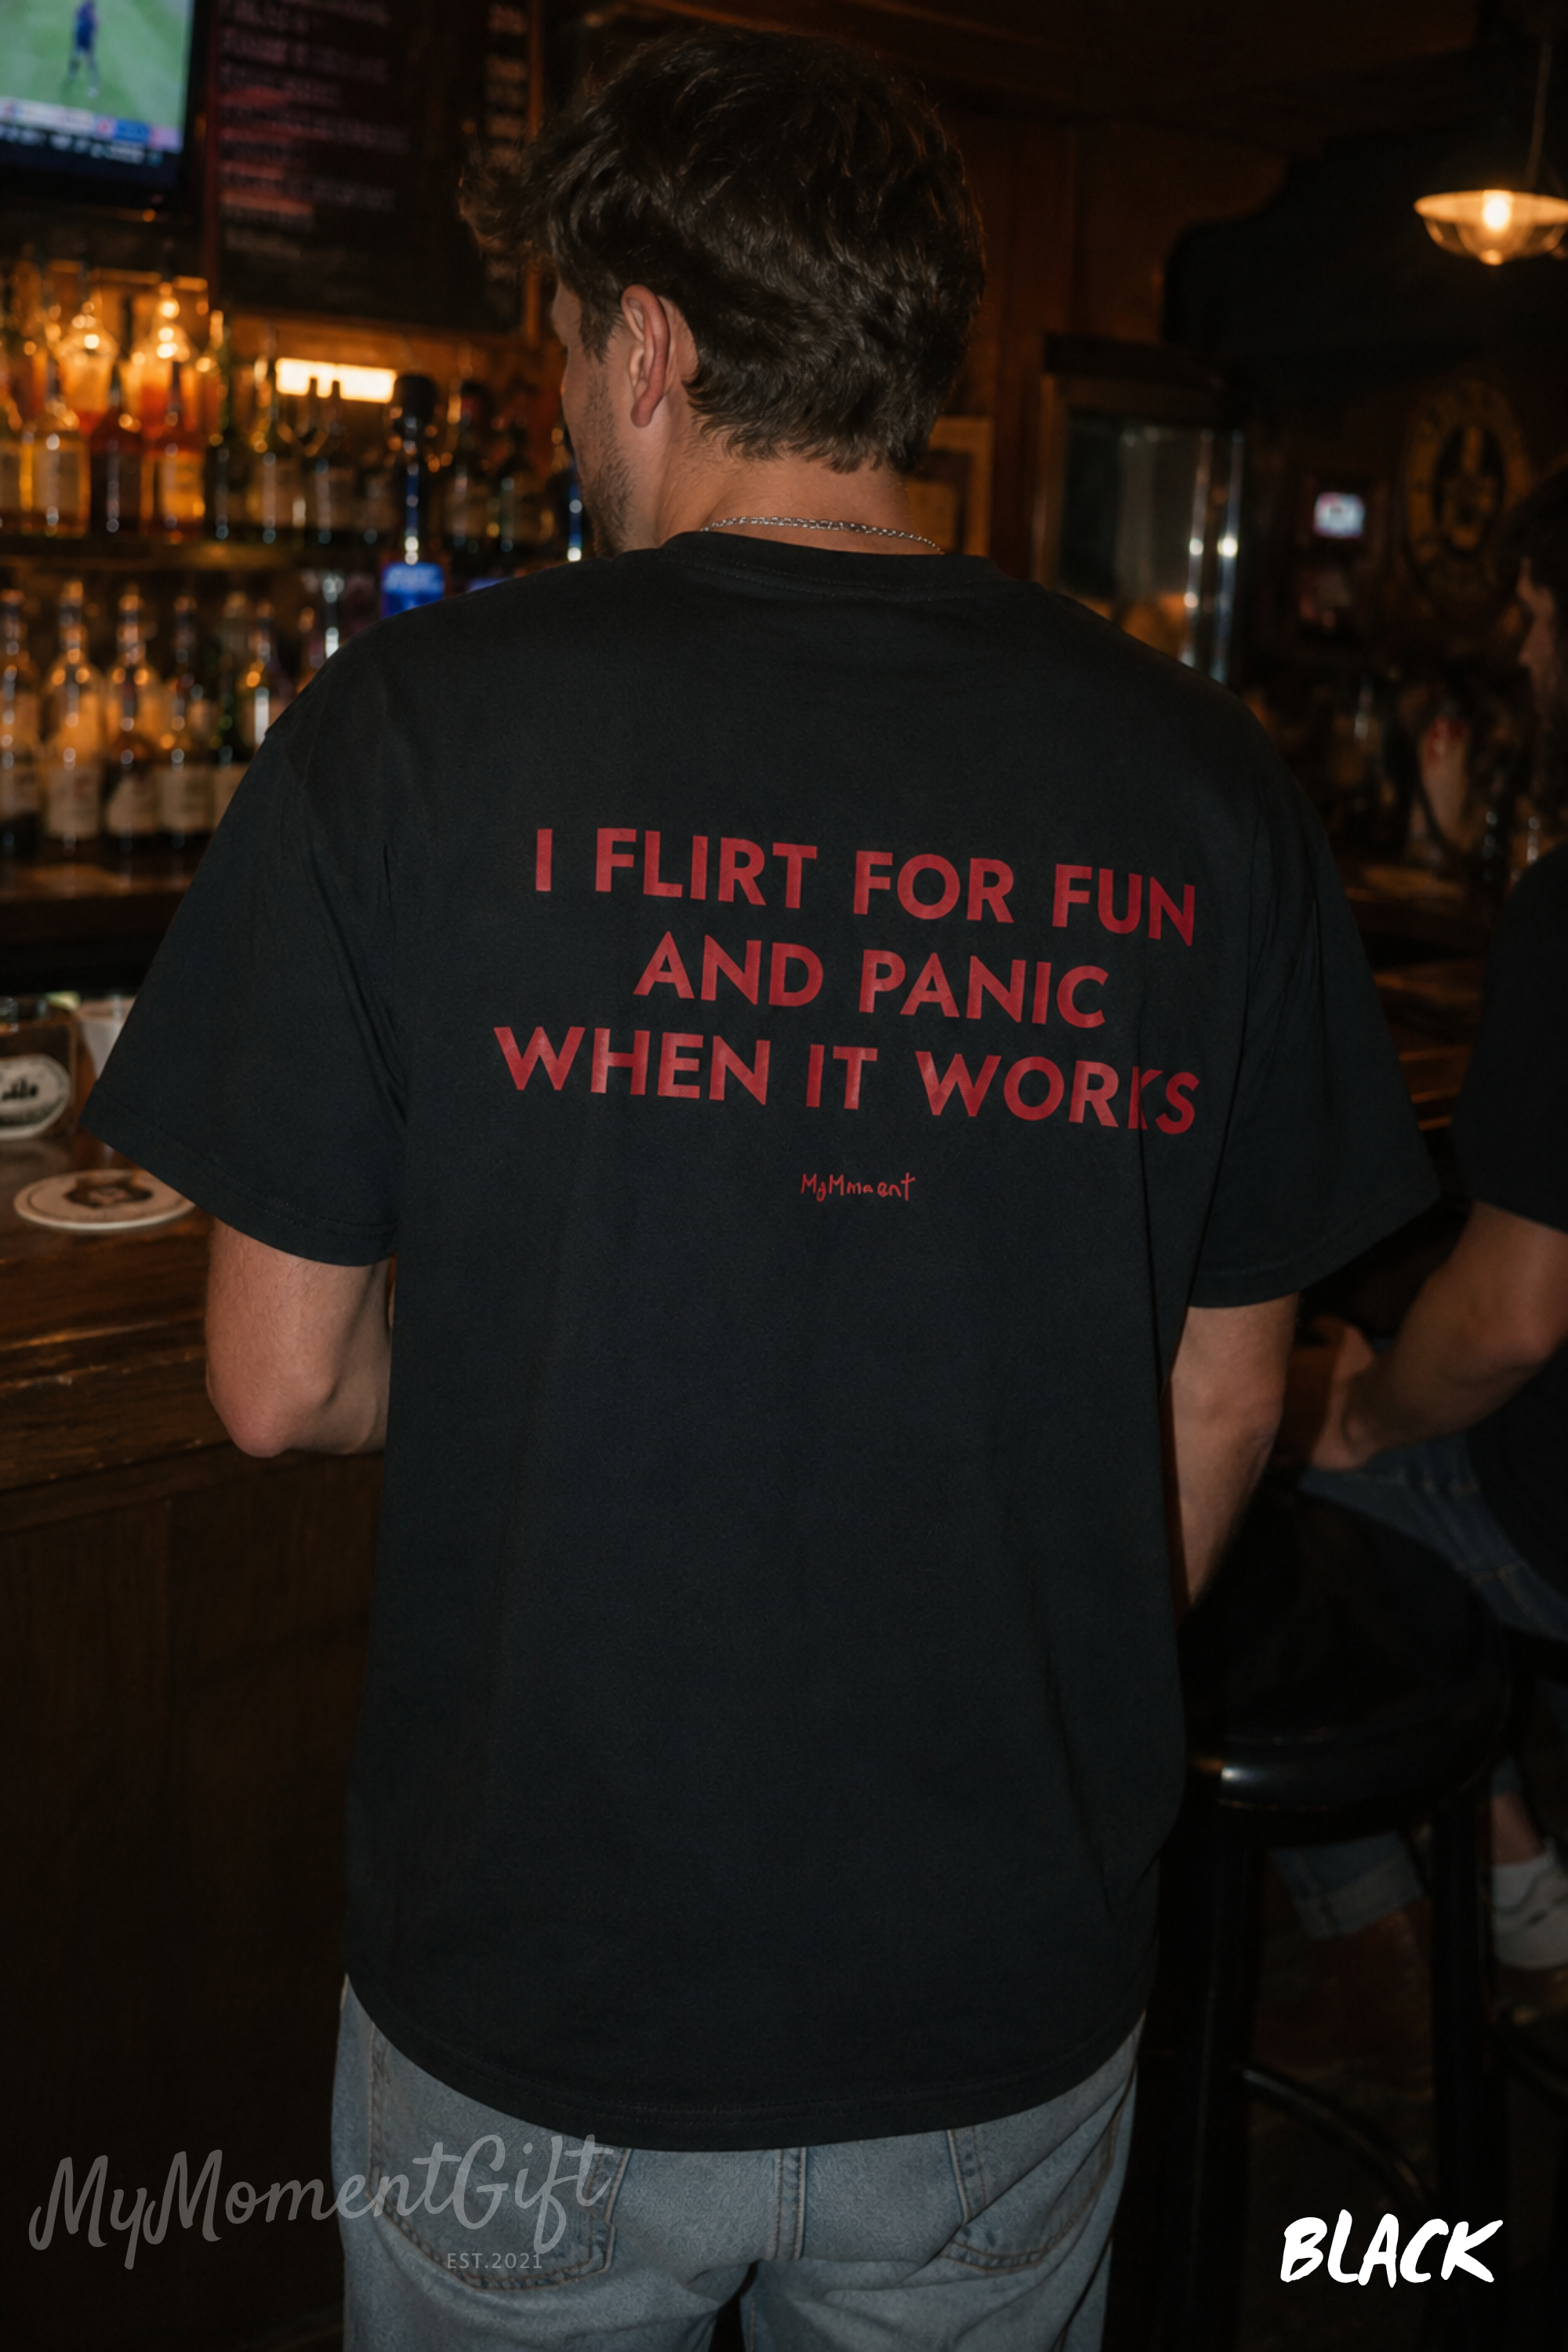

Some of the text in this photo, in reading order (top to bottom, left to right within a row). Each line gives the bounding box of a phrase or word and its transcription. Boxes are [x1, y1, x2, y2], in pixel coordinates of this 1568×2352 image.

[536, 827, 1196, 946] I FLIRT FOR FUN
[633, 931, 1109, 1029] AND PANIC
[493, 1025, 1200, 1135] WHEN IT WORKS
